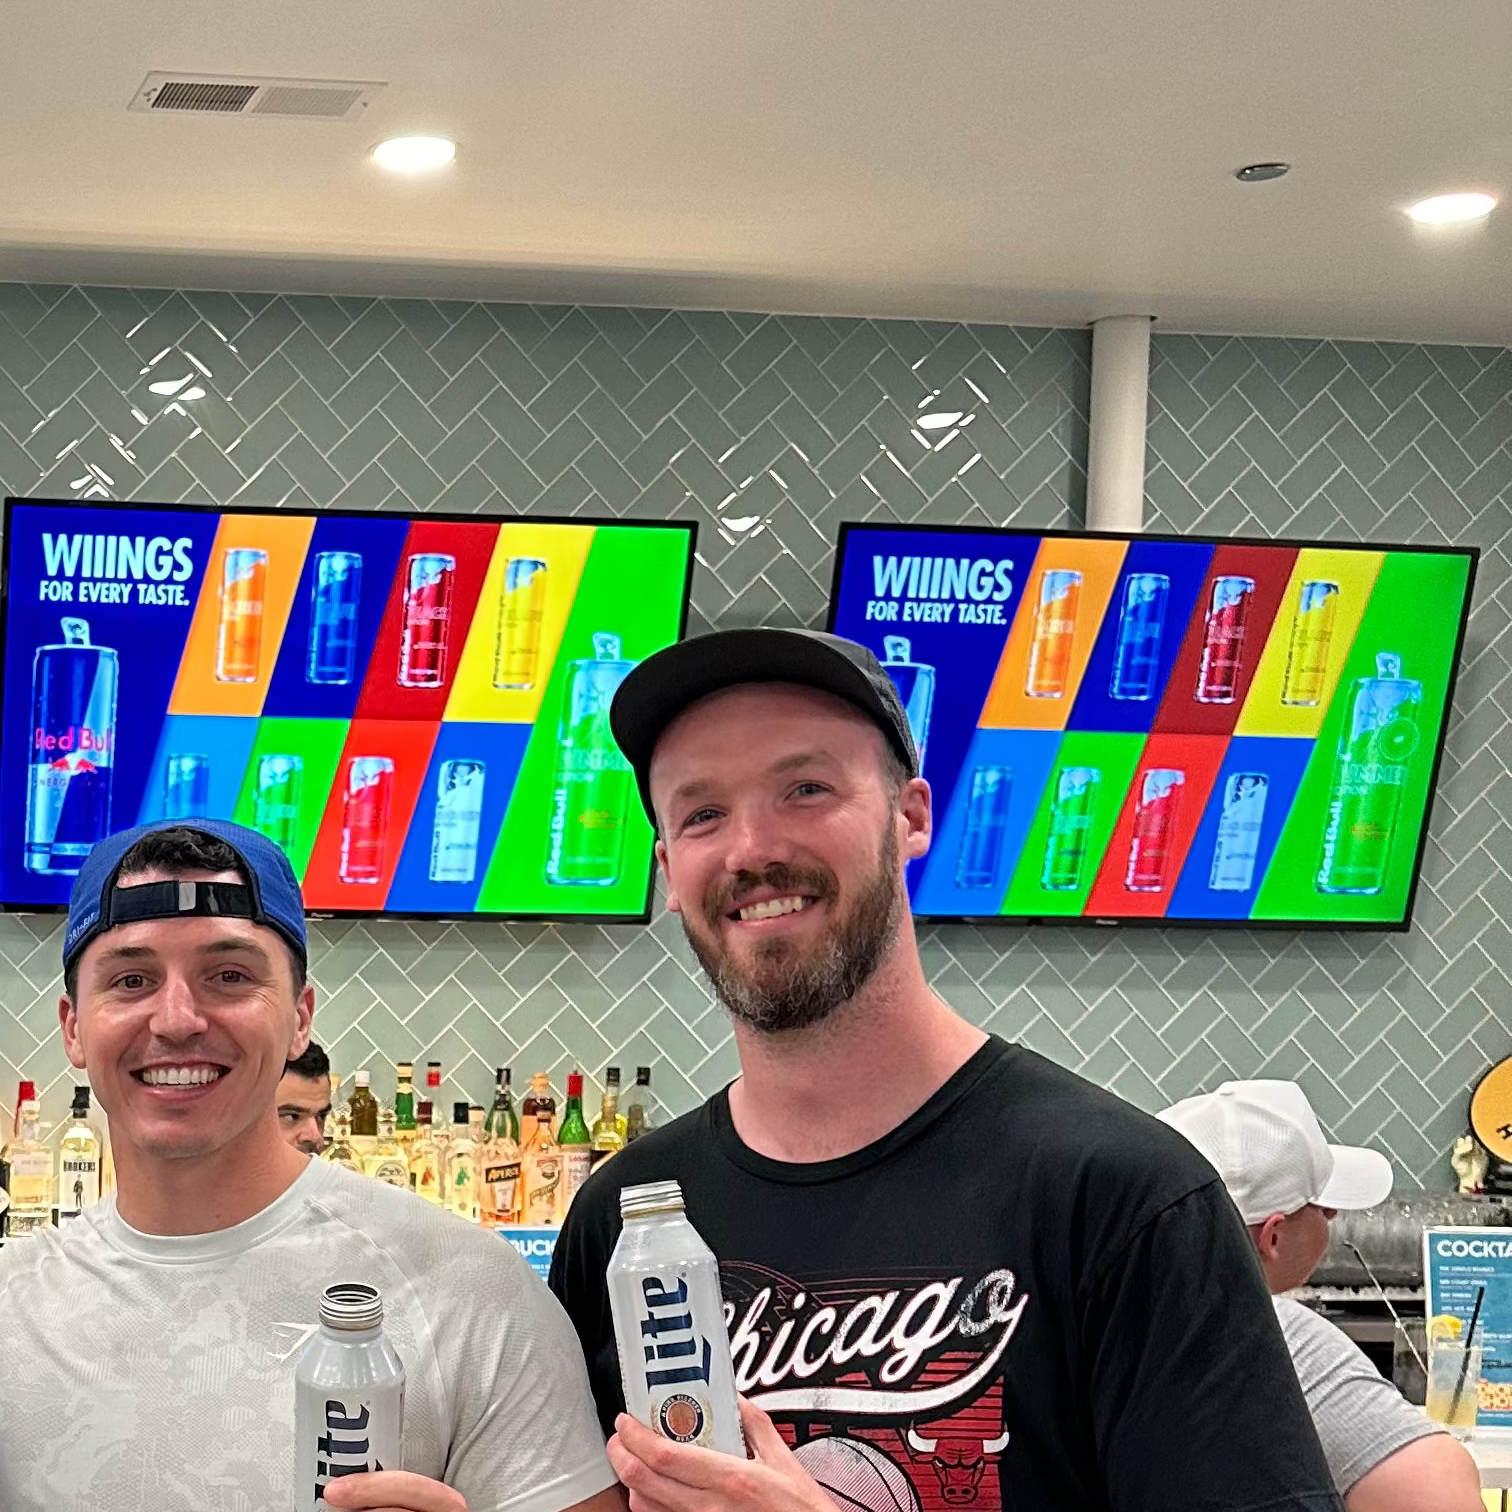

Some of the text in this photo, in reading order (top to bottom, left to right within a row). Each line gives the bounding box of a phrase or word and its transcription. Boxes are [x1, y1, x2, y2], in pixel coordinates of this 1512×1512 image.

[42, 533, 194, 582] WIIINGS
[872, 555, 1015, 602] WIIINGS
[39, 580, 190, 606] FOR EVERY TASTE.
[865, 600, 1008, 625] FOR EVERY TASTE.
[78, 728, 112, 752] Bul
[640, 1276, 712, 1394] Lite
[722, 1268, 1029, 1393] hicago
[313, 1399, 385, 1504] ite
